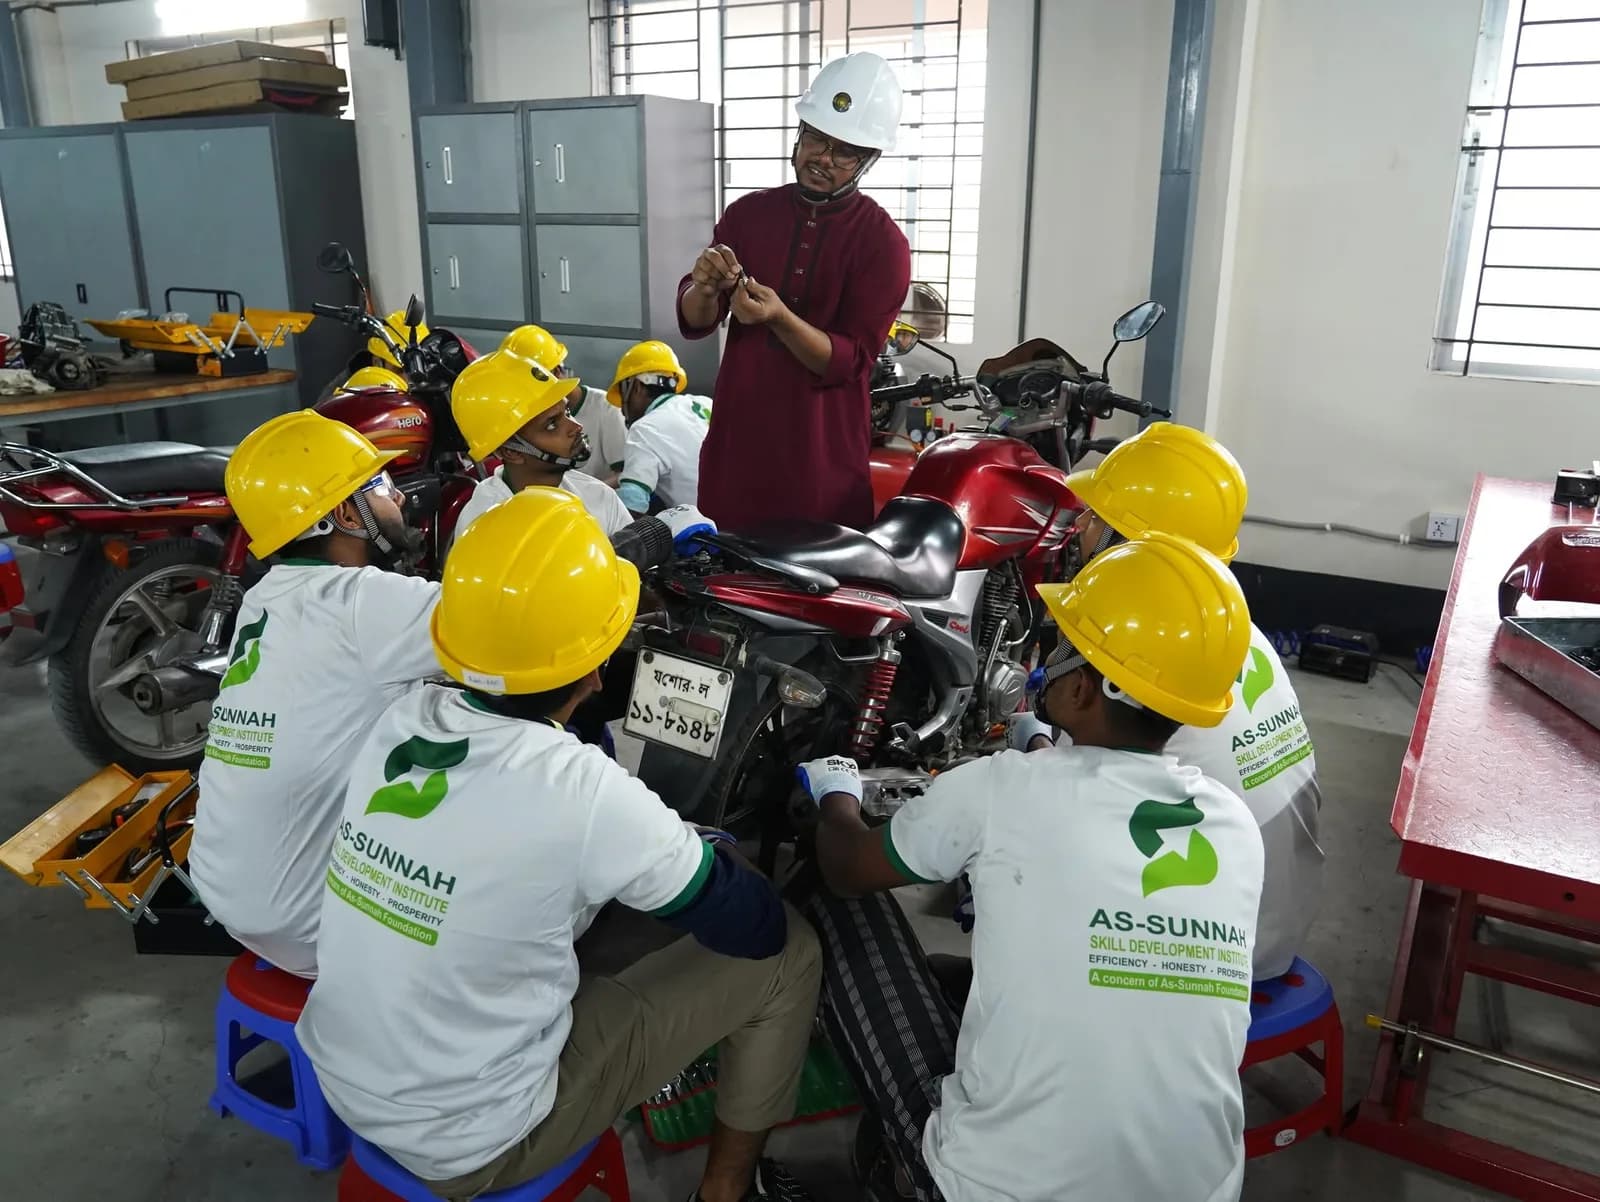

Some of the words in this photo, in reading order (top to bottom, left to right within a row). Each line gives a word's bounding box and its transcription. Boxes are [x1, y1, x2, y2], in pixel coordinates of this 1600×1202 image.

[398, 416, 422, 428] Hero
[213, 705, 276, 728] SUNNAH
[1231, 704, 1299, 752] AS-SUNNA
[1235, 749, 1258, 766] SKILL
[350, 875, 381, 899] HONESTY
[387, 897, 444, 927] PROSPERITY
[392, 879, 449, 914] INSTITUTE
[383, 911, 433, 942] Foundation
[1088, 908, 1247, 949] AS-SUNNAH
[1090, 934, 1126, 952] SKILL
[1129, 938, 1216, 960] DEVELOPMENT
[1088, 953, 1148, 969] EFFICIENCY
[1161, 960, 1207, 974] HONESTY
[1091, 970, 1100, 983] A
[1103, 974, 1145, 987] concern
[1148, 976, 1158, 988] of
[1161, 976, 1214, 993] As-Sunnah
